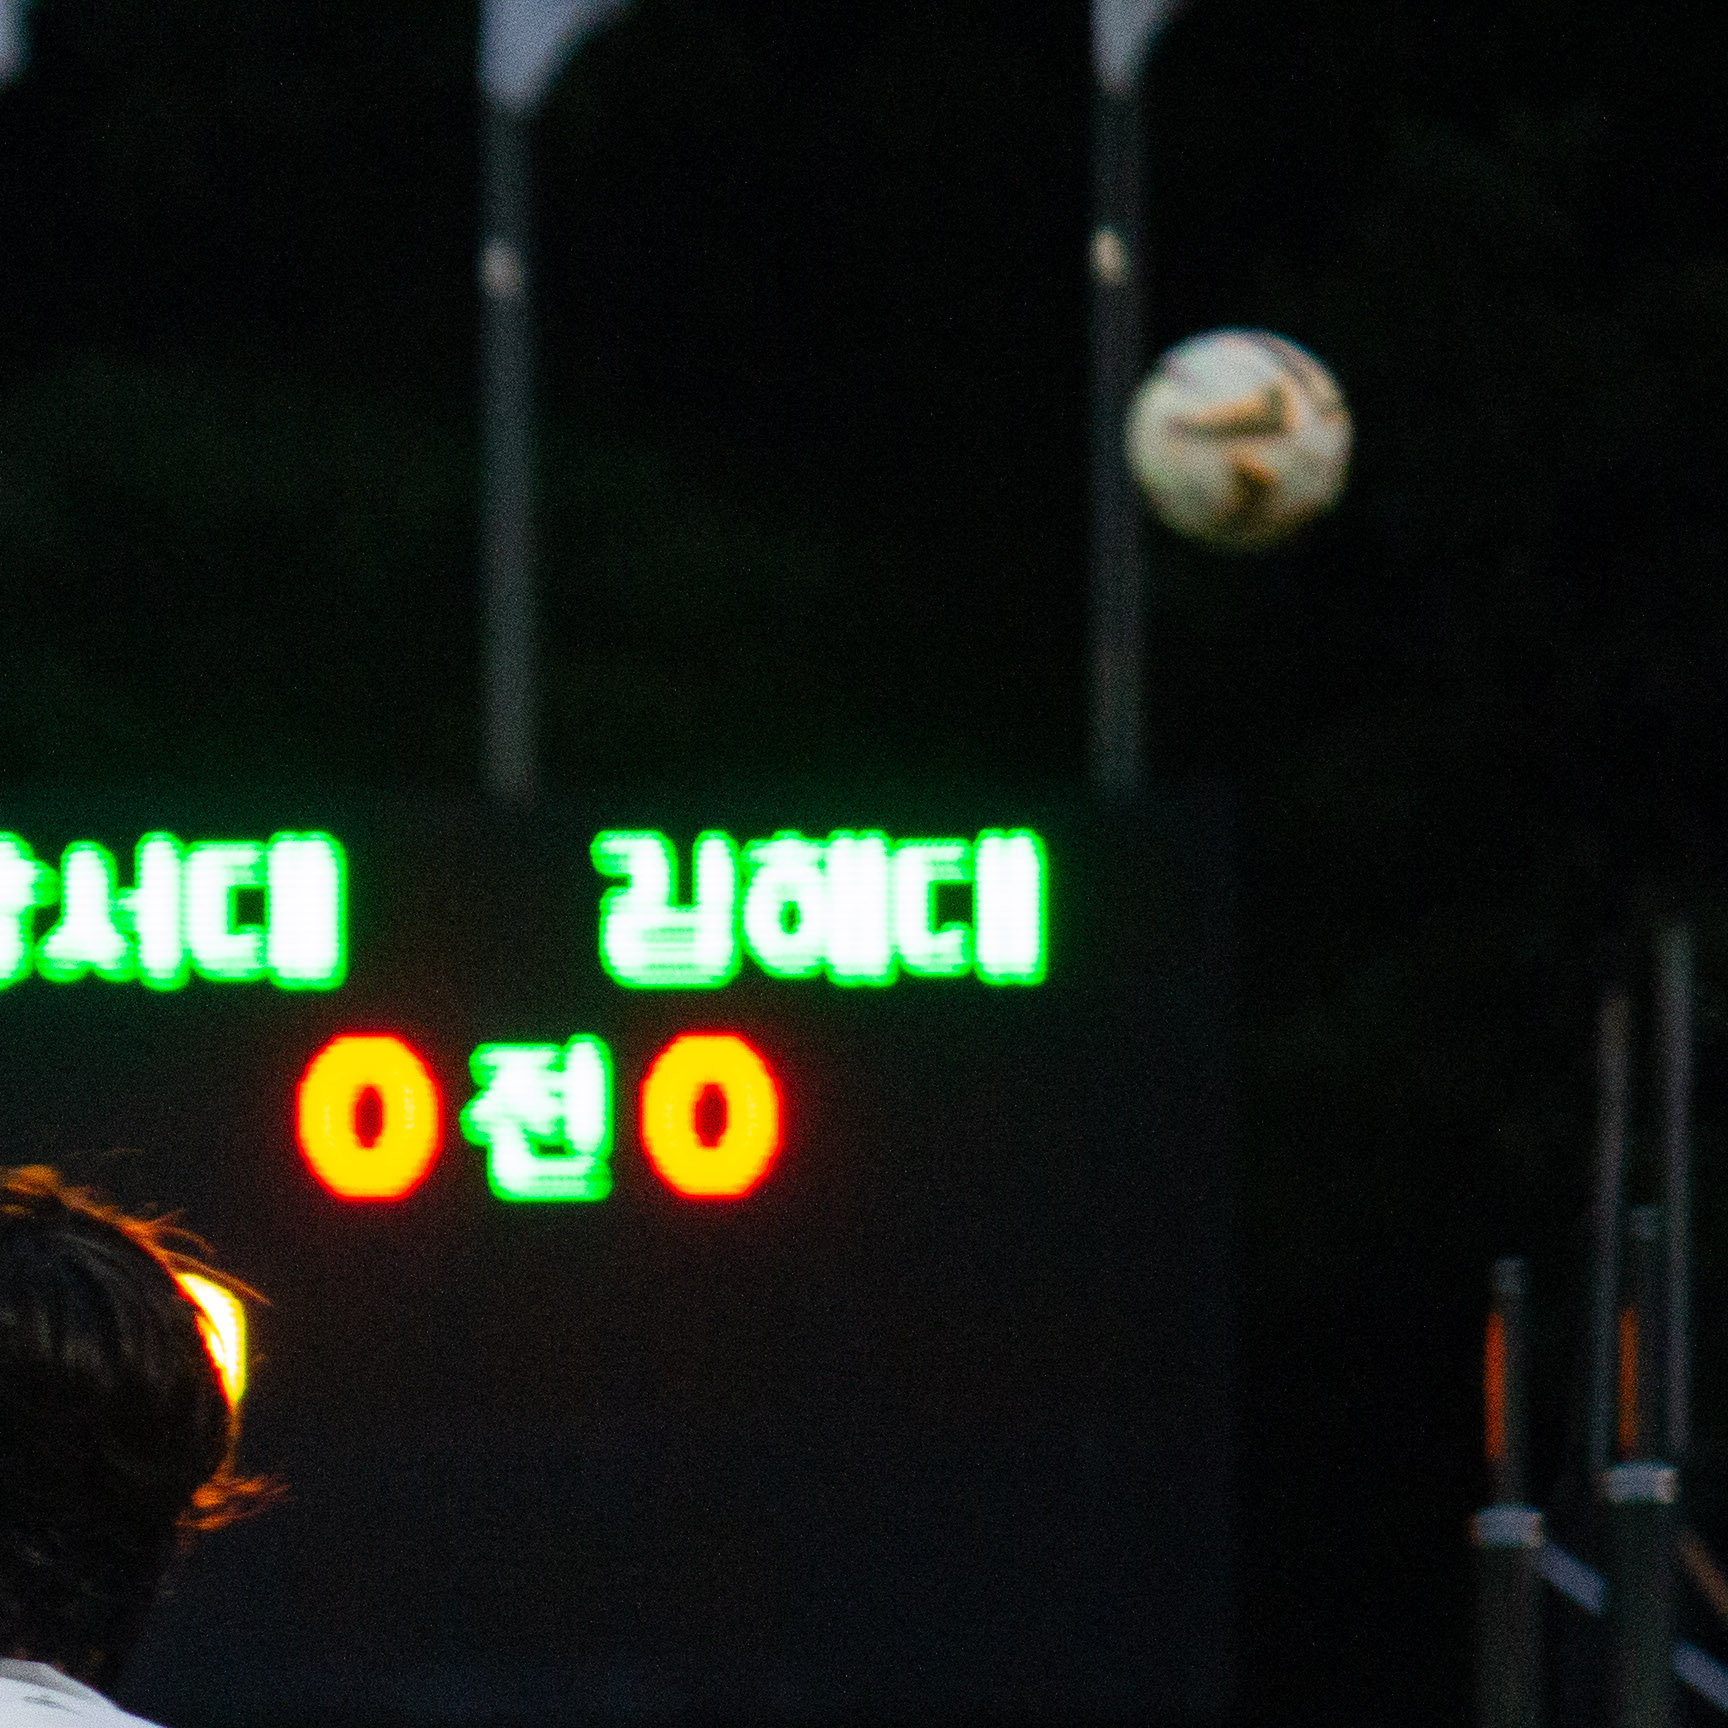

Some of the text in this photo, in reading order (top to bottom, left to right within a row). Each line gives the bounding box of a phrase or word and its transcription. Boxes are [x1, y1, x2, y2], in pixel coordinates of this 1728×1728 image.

[590, 827, 1049, 990] 김해대
[294, 1030, 788, 1203] 0 전 0
